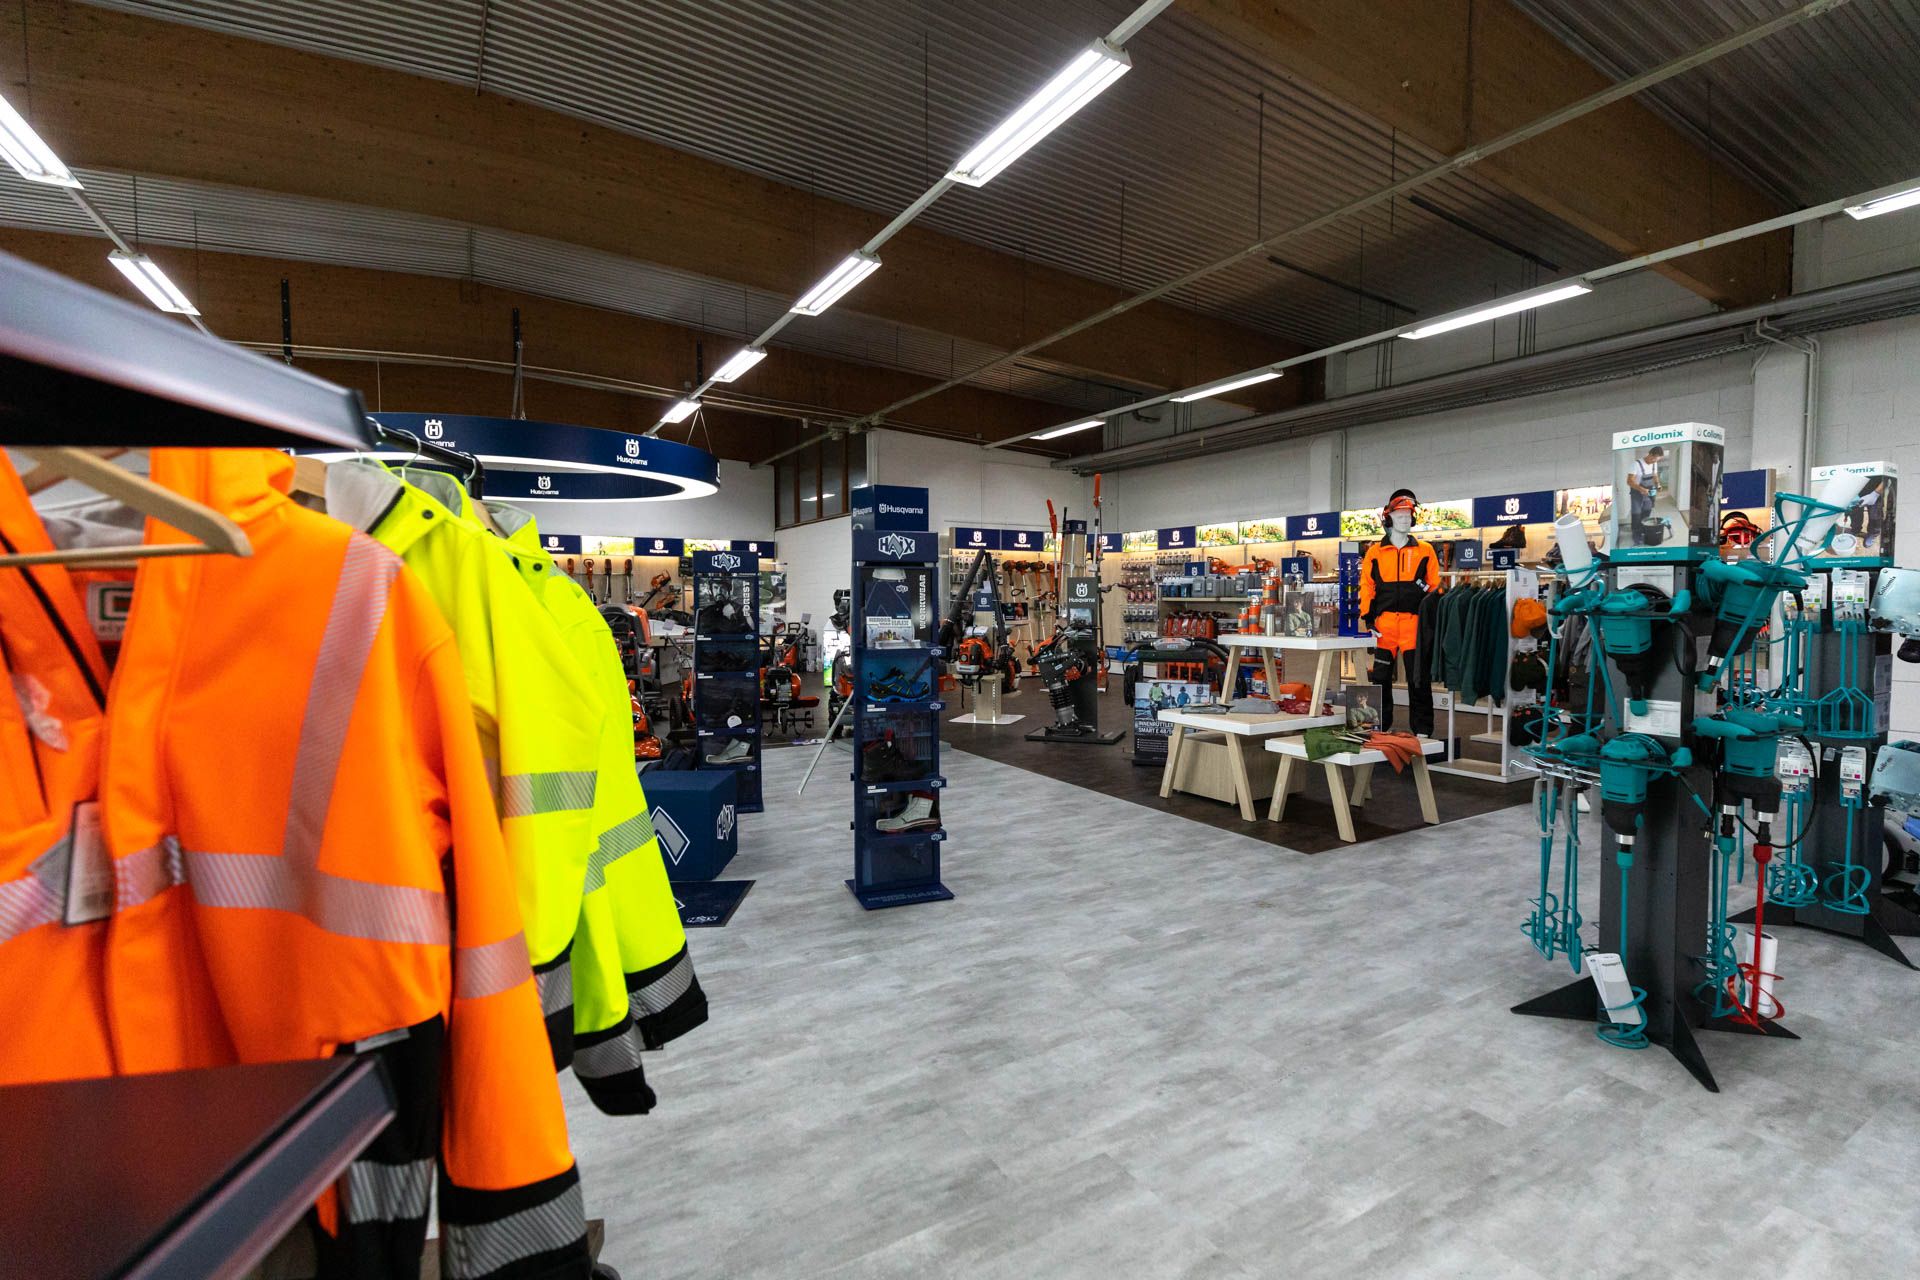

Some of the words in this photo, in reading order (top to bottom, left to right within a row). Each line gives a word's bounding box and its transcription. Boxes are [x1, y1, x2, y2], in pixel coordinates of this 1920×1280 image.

[1632, 429, 1684, 443] Collomix
[616, 455, 648, 466] Husqvarna
[887, 505, 924, 515] Husqvarna
[1496, 513, 1528, 521] Husqvarna
[742, 580, 751, 617] FOREST
[919, 574, 927, 630] WORKWEAR
